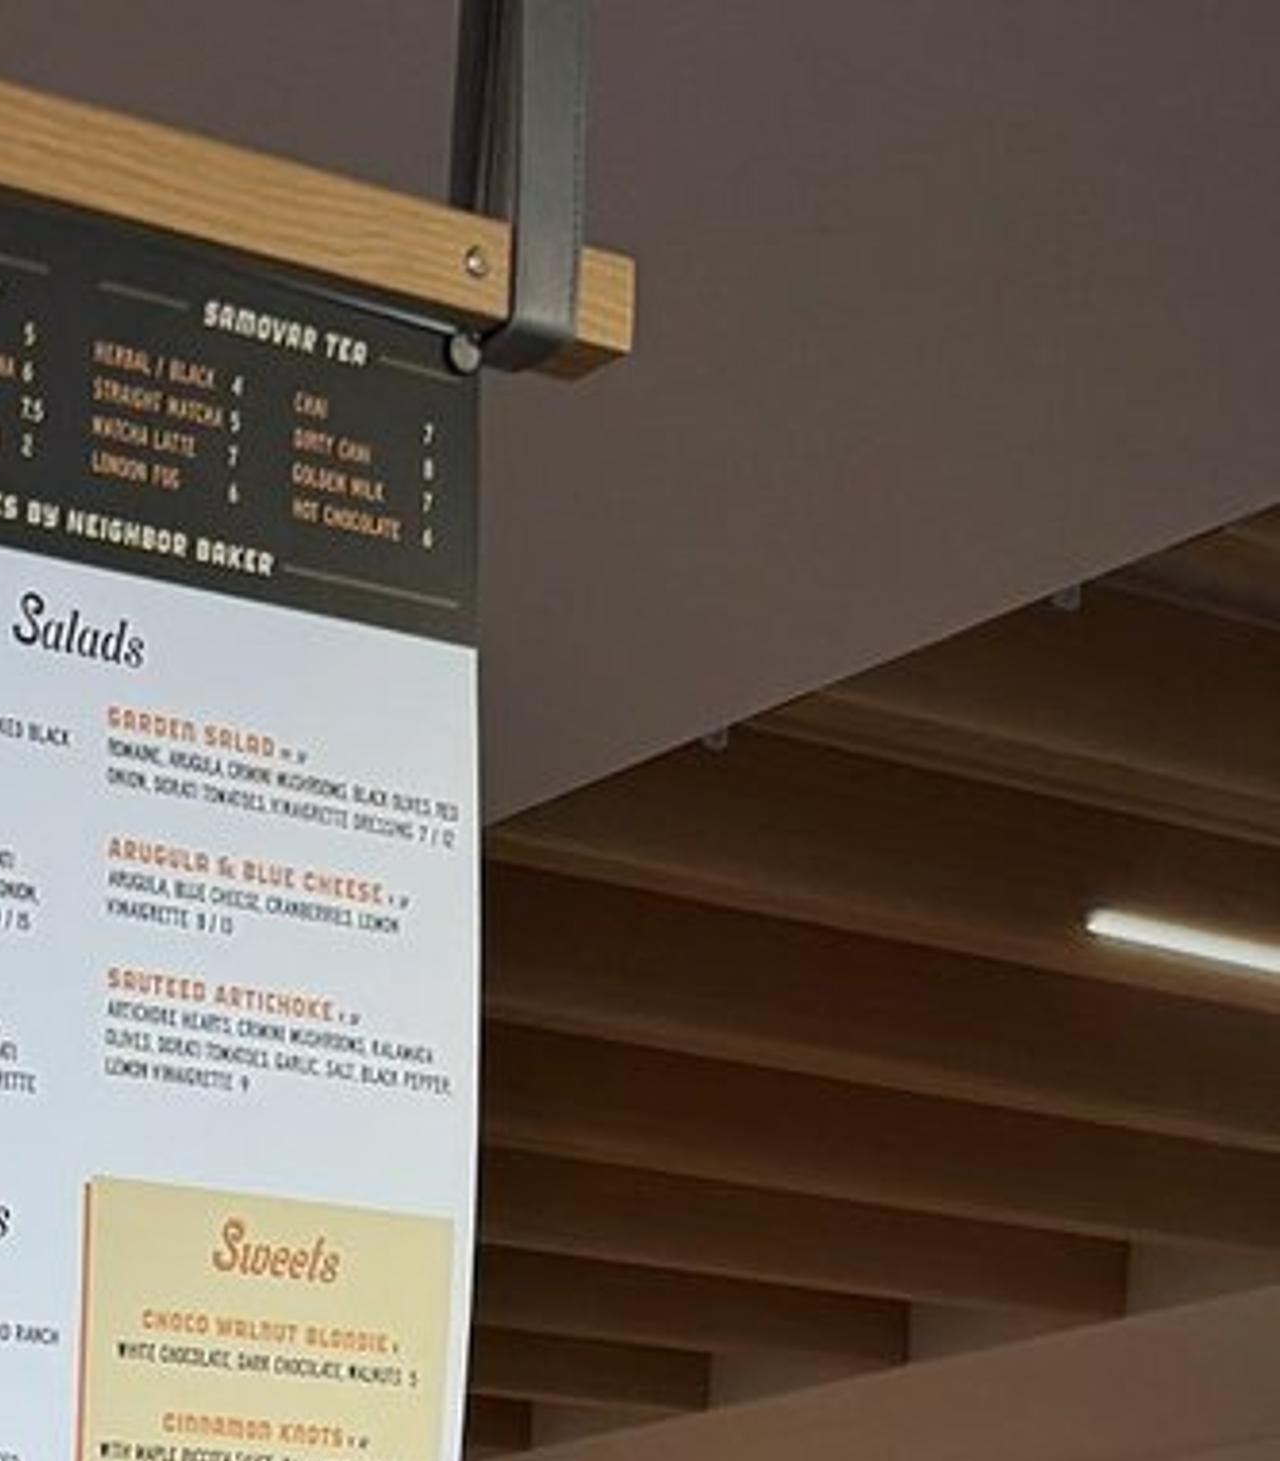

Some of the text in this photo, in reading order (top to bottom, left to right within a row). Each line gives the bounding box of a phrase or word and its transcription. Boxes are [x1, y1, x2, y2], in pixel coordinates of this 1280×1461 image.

[203, 299, 367, 367] SAMOVAR TEA
[26, 499, 60, 530] BY
[66, 508, 188, 557] NEIGHBOR
[195, 536, 274, 576] BAKER
[12, 590, 145, 669] Salads
[106, 705, 275, 759] GARDEN SALAD
[107, 836, 383, 906] ARUGULA & BLUE CHEESE
[211, 1219, 341, 1285] Sweets
